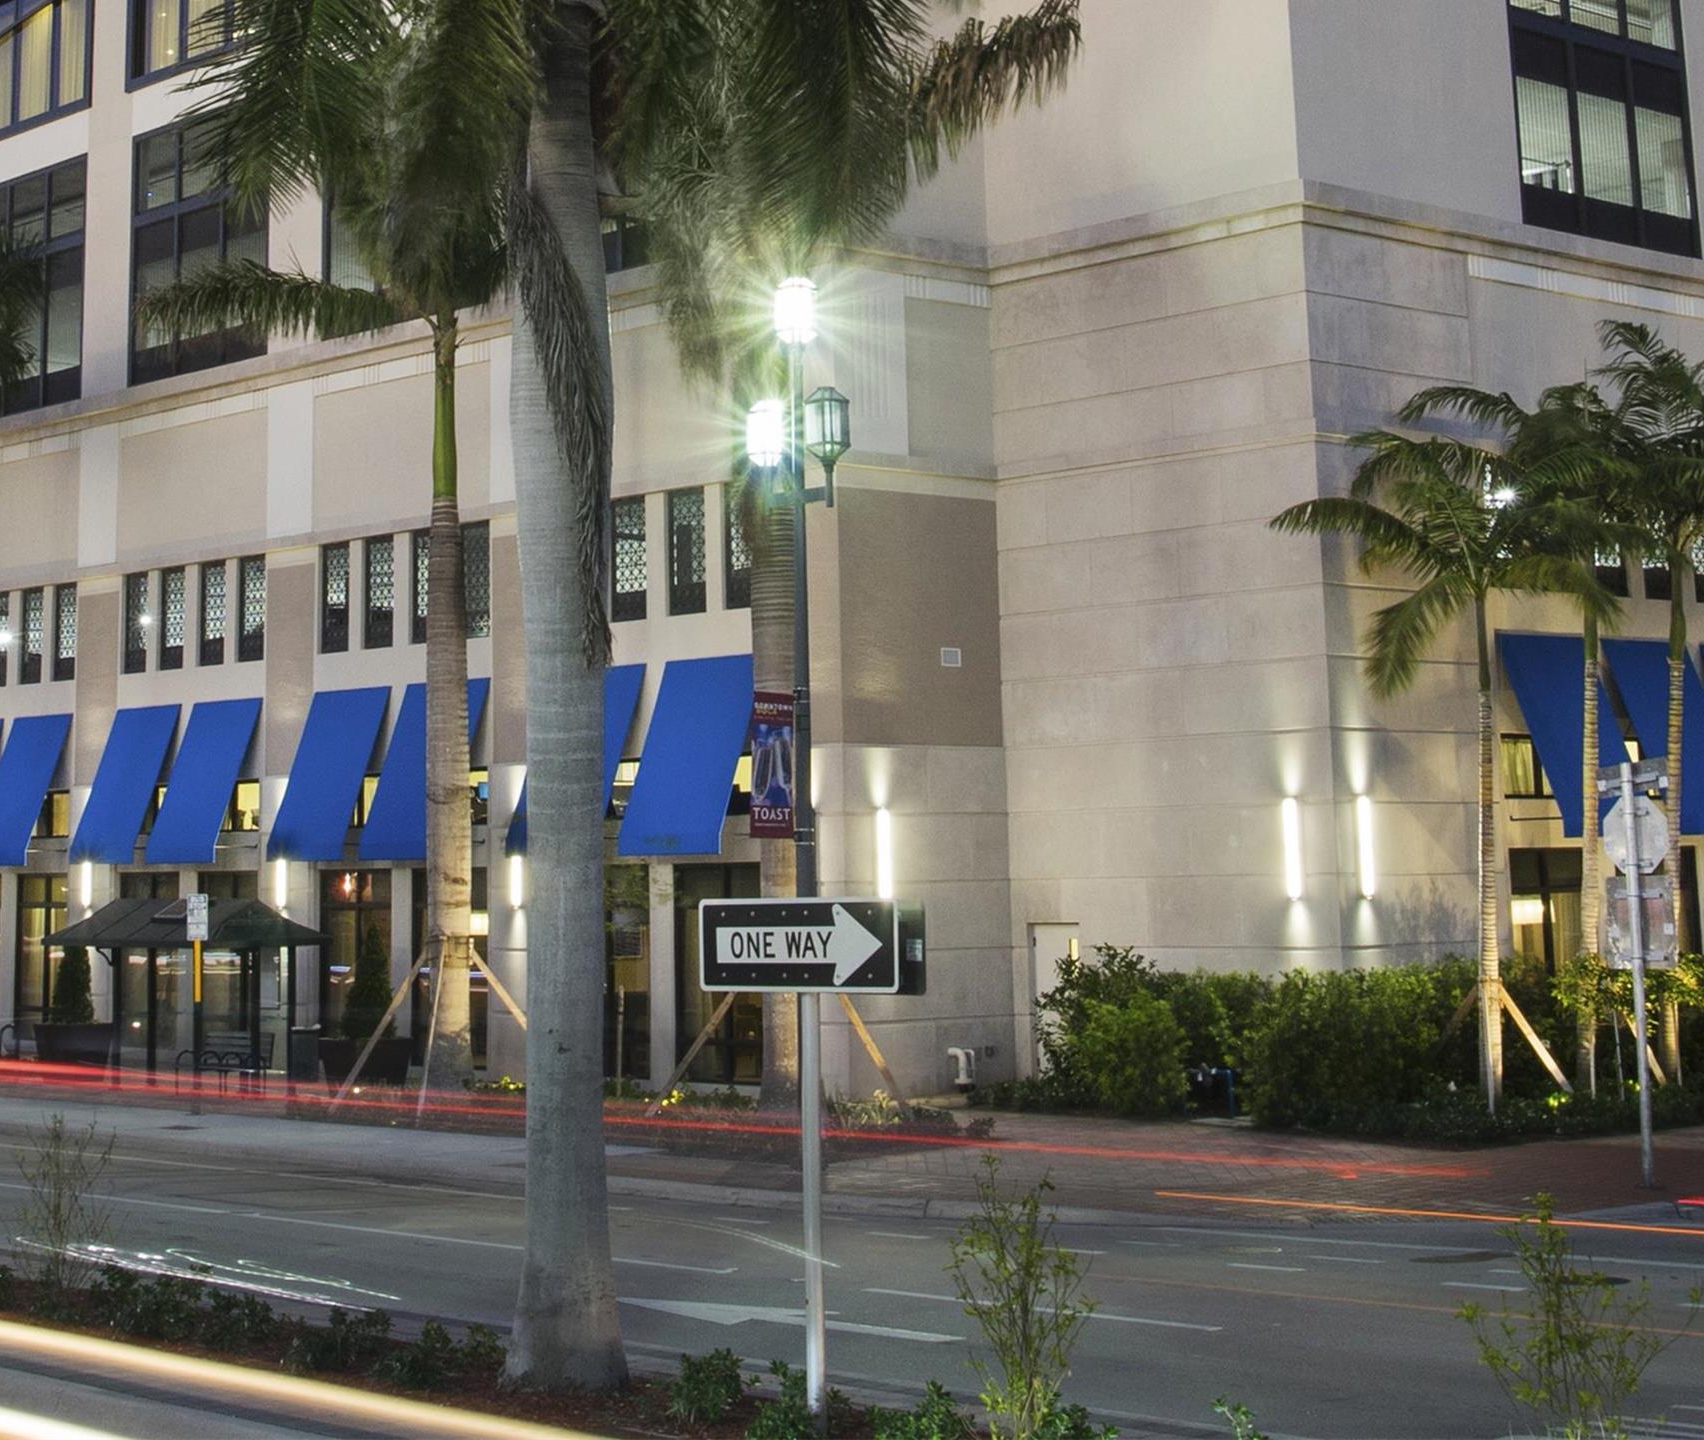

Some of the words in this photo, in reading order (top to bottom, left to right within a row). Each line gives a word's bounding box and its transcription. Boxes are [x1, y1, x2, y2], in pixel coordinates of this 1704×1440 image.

[752, 806, 791, 820] TOAST
[730, 931, 776, 959] ONE
[785, 931, 832, 959] WAY
